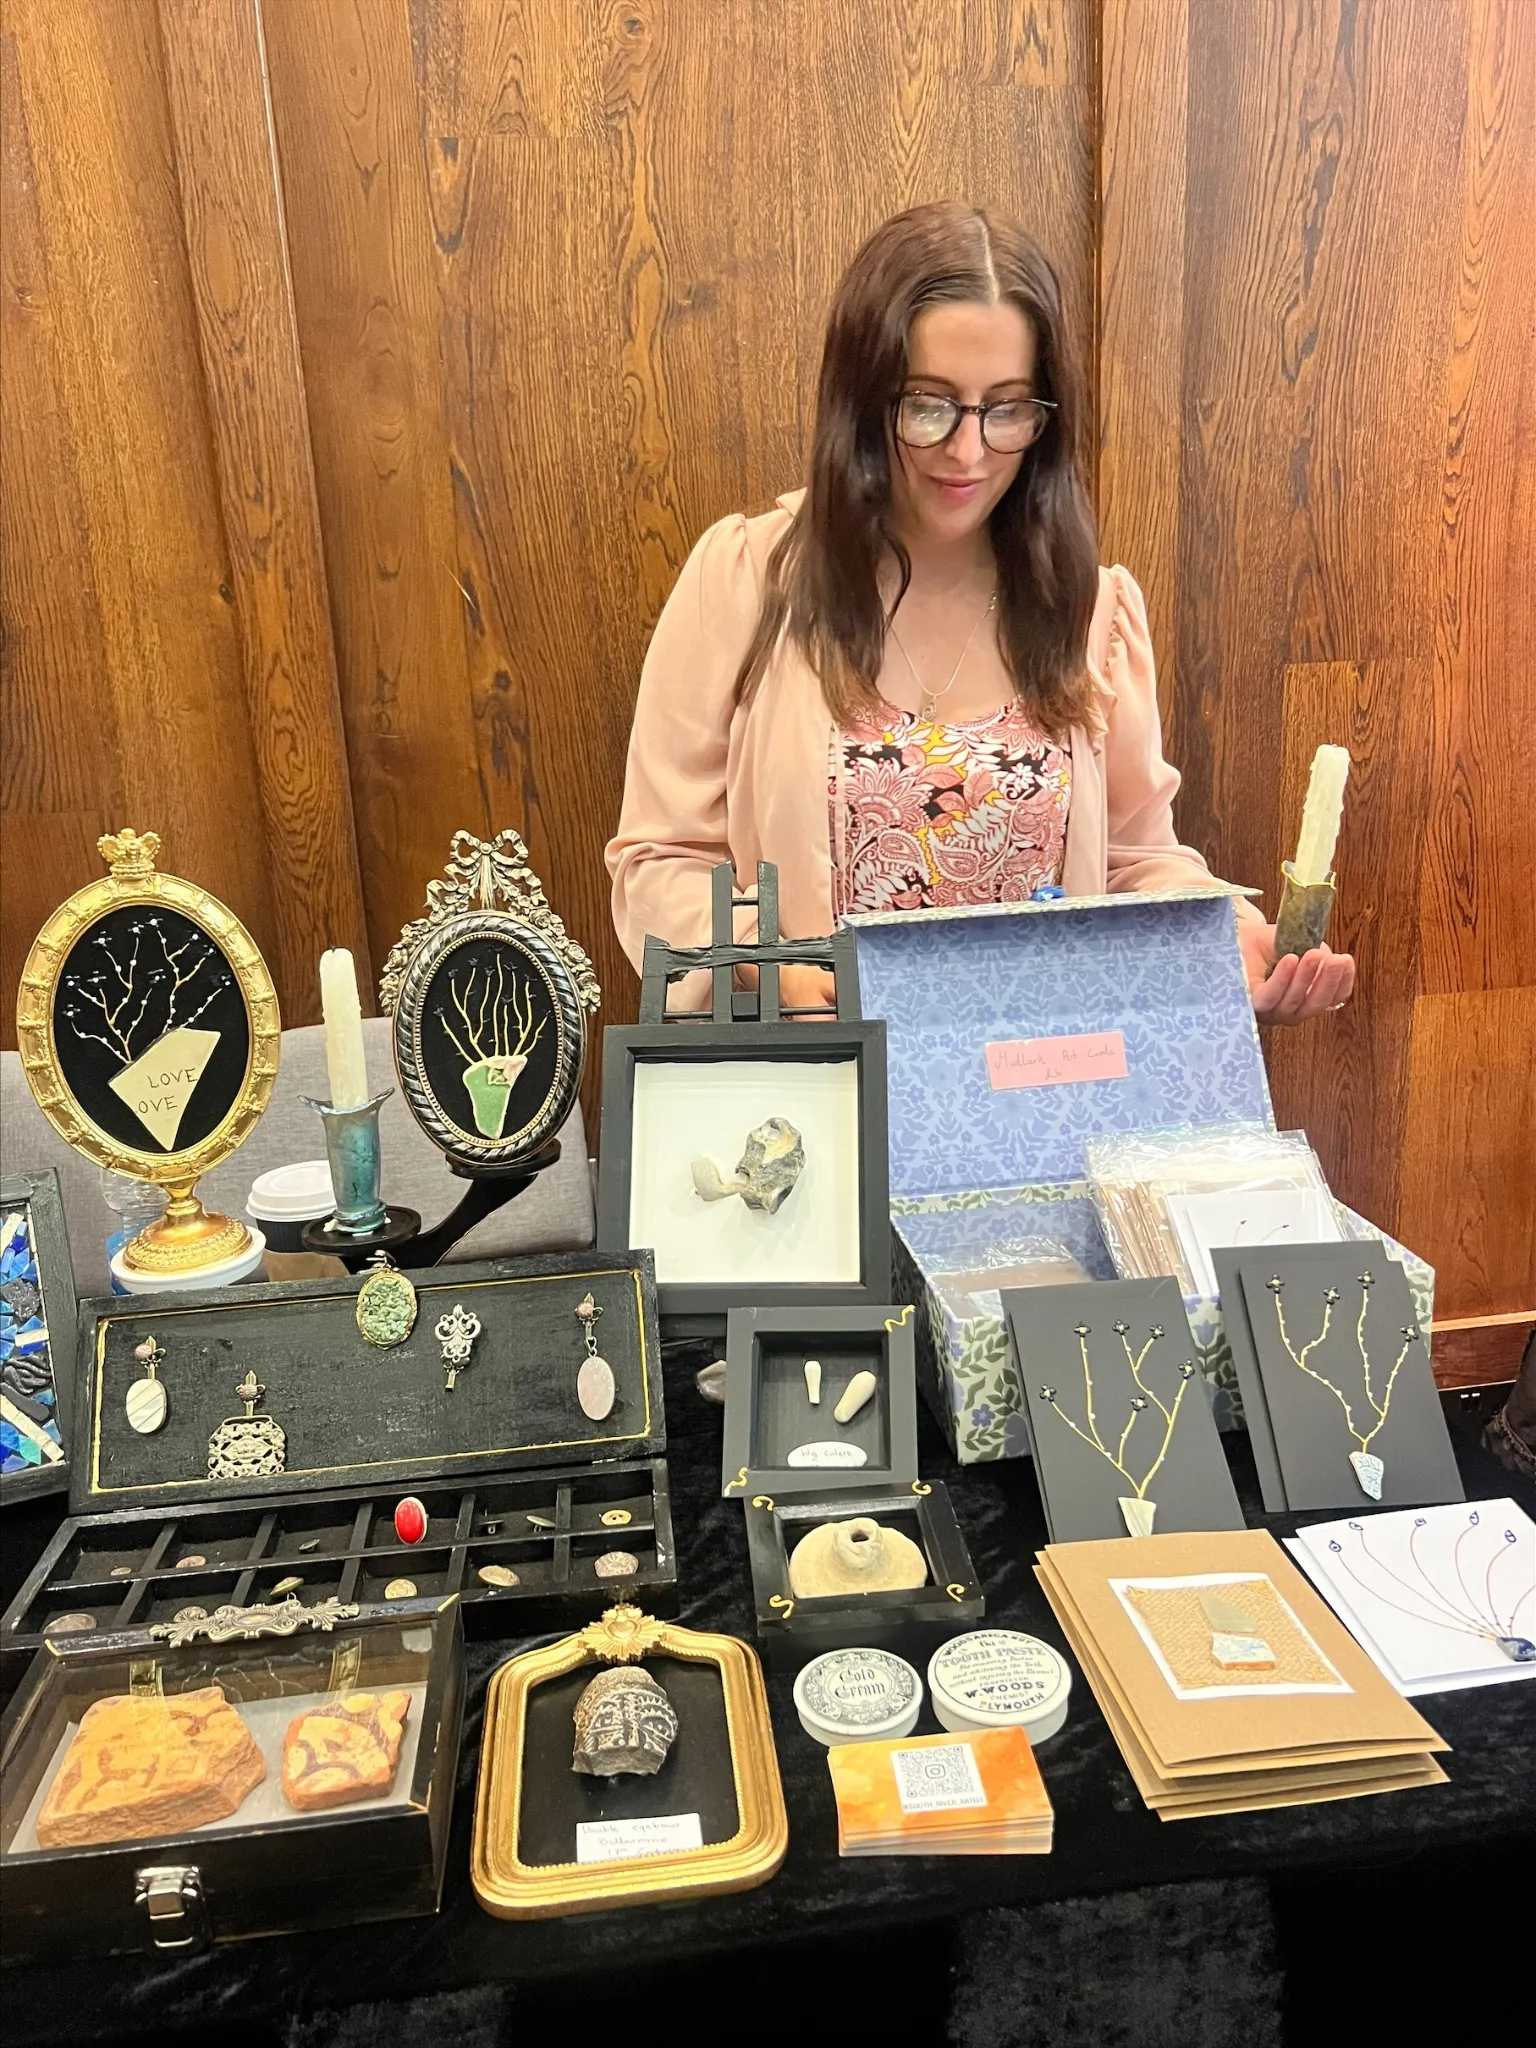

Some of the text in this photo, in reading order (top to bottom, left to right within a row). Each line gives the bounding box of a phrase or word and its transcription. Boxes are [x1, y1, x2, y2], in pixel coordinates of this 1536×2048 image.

[1062, 1050, 1078, 1062] Art
[1086, 1044, 1115, 1058] Cards
[147, 1067, 198, 1089] LOVE
[1010, 1634, 1035, 1645] NUT
[939, 1646, 1046, 1669] TOOTH PASTE
[839, 1668, 876, 1682] Cold
[834, 1682, 886, 1699] Cream
[981, 1681, 1046, 1695] WOODS
[990, 1690, 1030, 1701] CHEMIST
[979, 1692, 1046, 1711] PLYMOUTH
